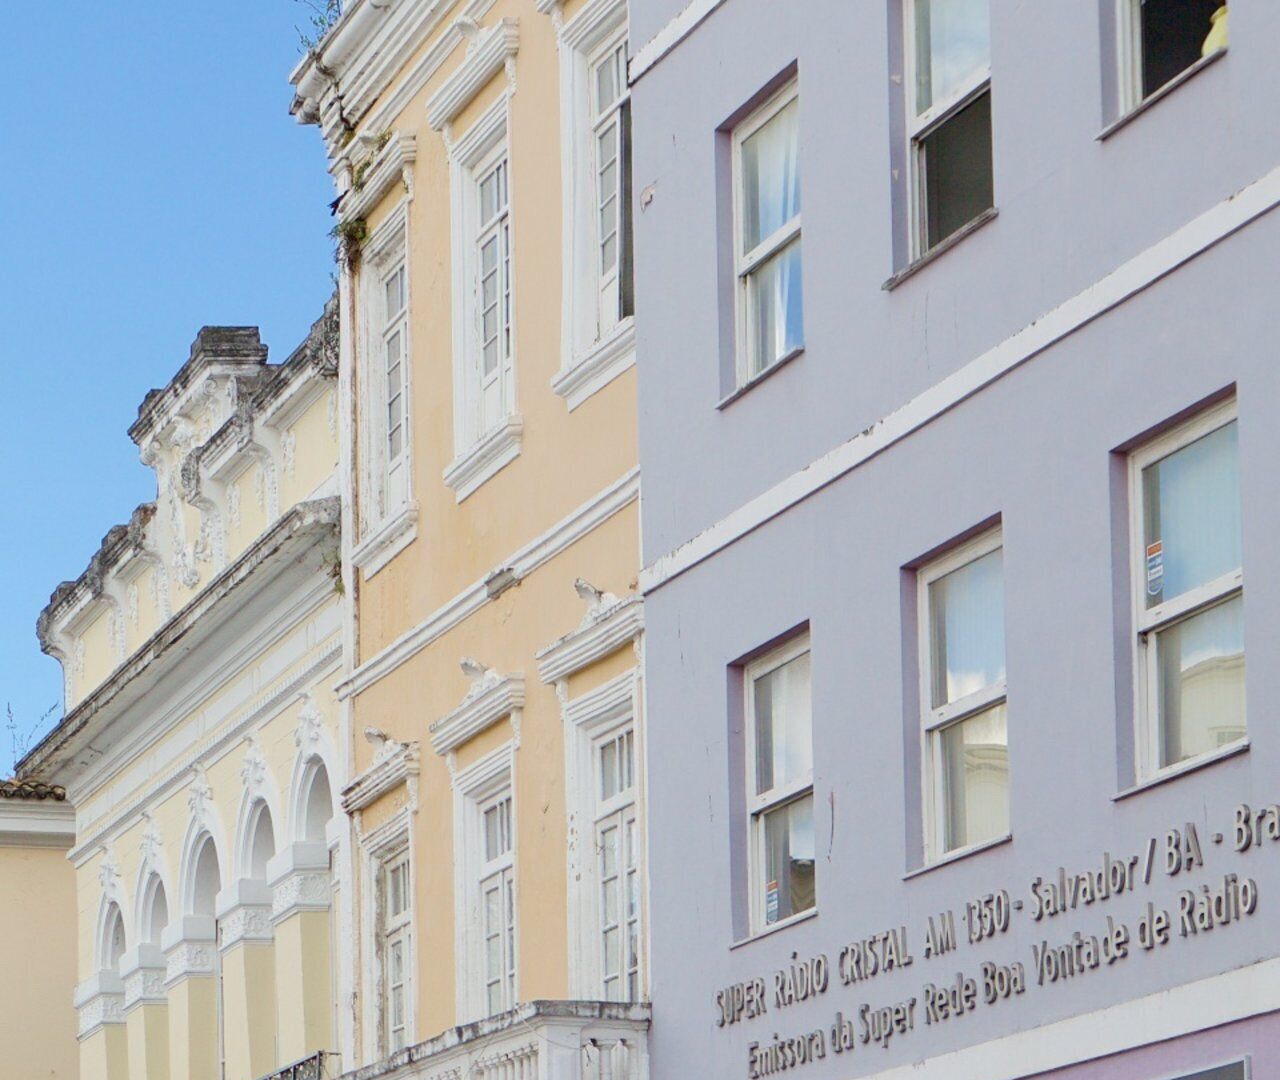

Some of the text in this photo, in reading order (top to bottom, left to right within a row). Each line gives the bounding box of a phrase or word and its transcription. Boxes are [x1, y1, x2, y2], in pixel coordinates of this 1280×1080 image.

[716, 978, 767, 1027] SUPER
[774, 951, 829, 1008] RÁDIO
[839, 926, 913, 986] CRISTAL
[924, 910, 957, 959] AM
[963, 889, 1010, 944] 1350
[1030, 852, 1139, 921] Salvador
[1166, 822, 1204, 876] BA
[748, 873, 1259, 1080] Emissora da Super Rede Boa Vontade de Rádio
